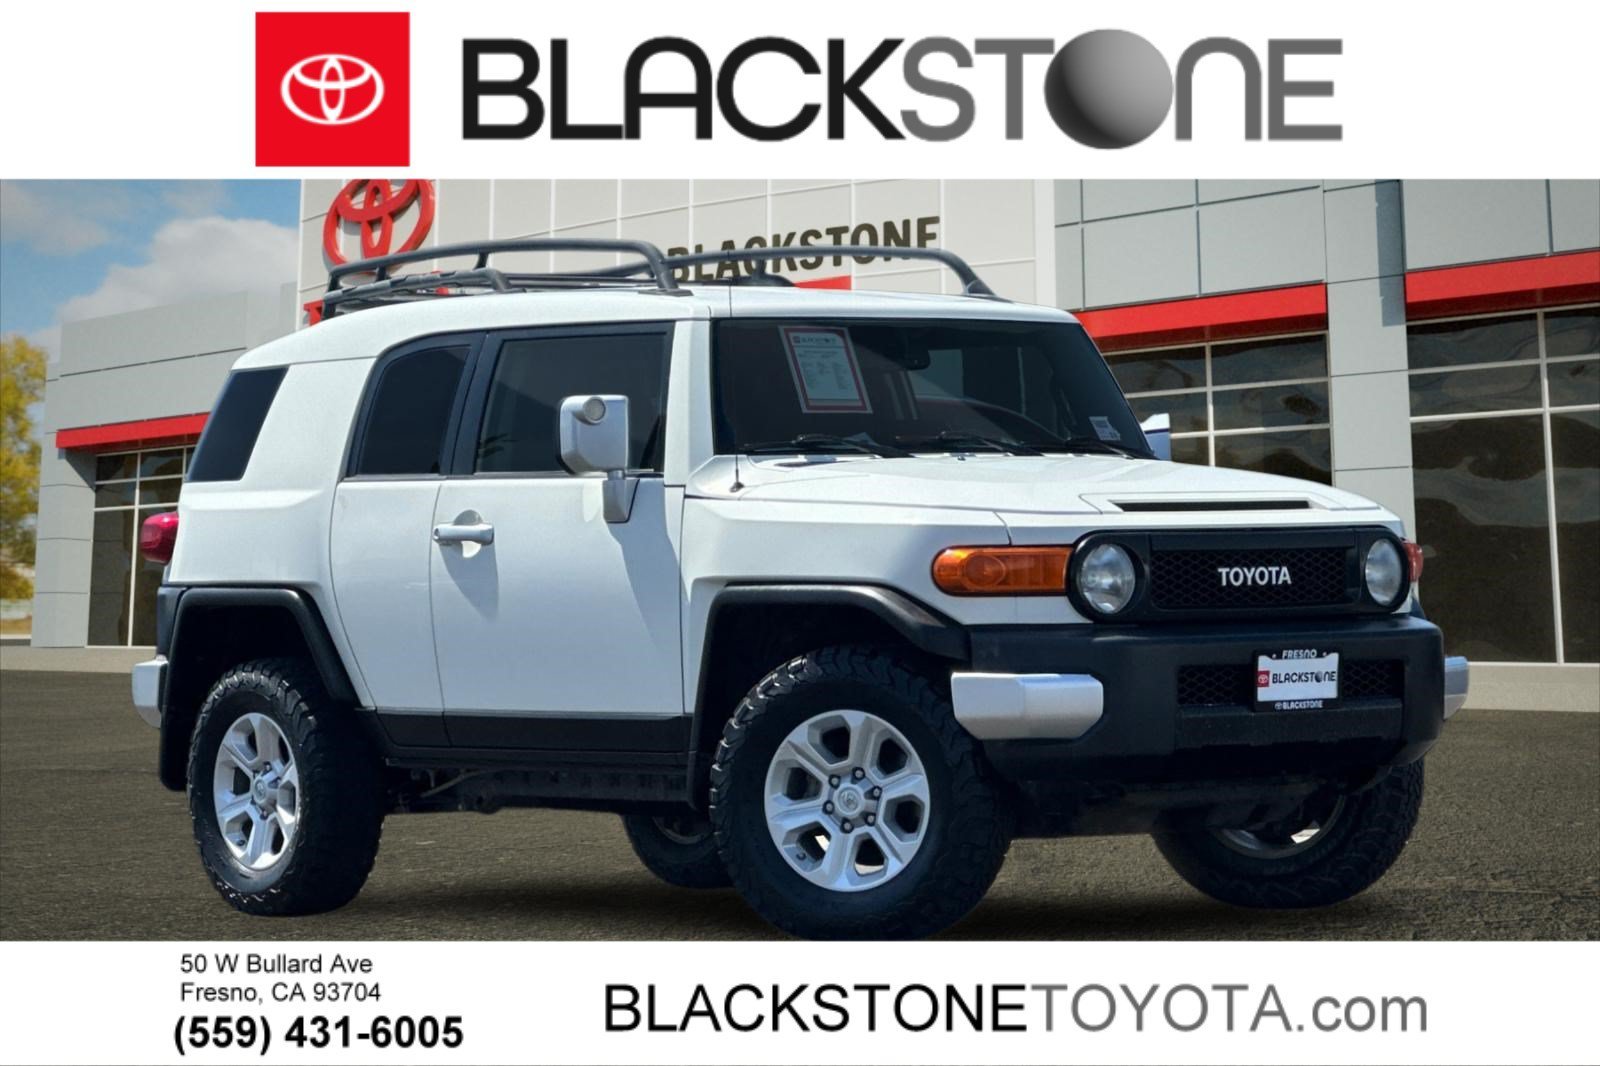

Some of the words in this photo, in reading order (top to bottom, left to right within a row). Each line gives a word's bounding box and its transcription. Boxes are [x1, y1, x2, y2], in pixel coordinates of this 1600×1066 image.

[1218, 566, 1292, 587] TOYOTA
[1282, 649, 1317, 659] FRESNO
[1272, 671, 1337, 684] BLACKSTONE
[1282, 700, 1323, 710] BLACKSTONE
